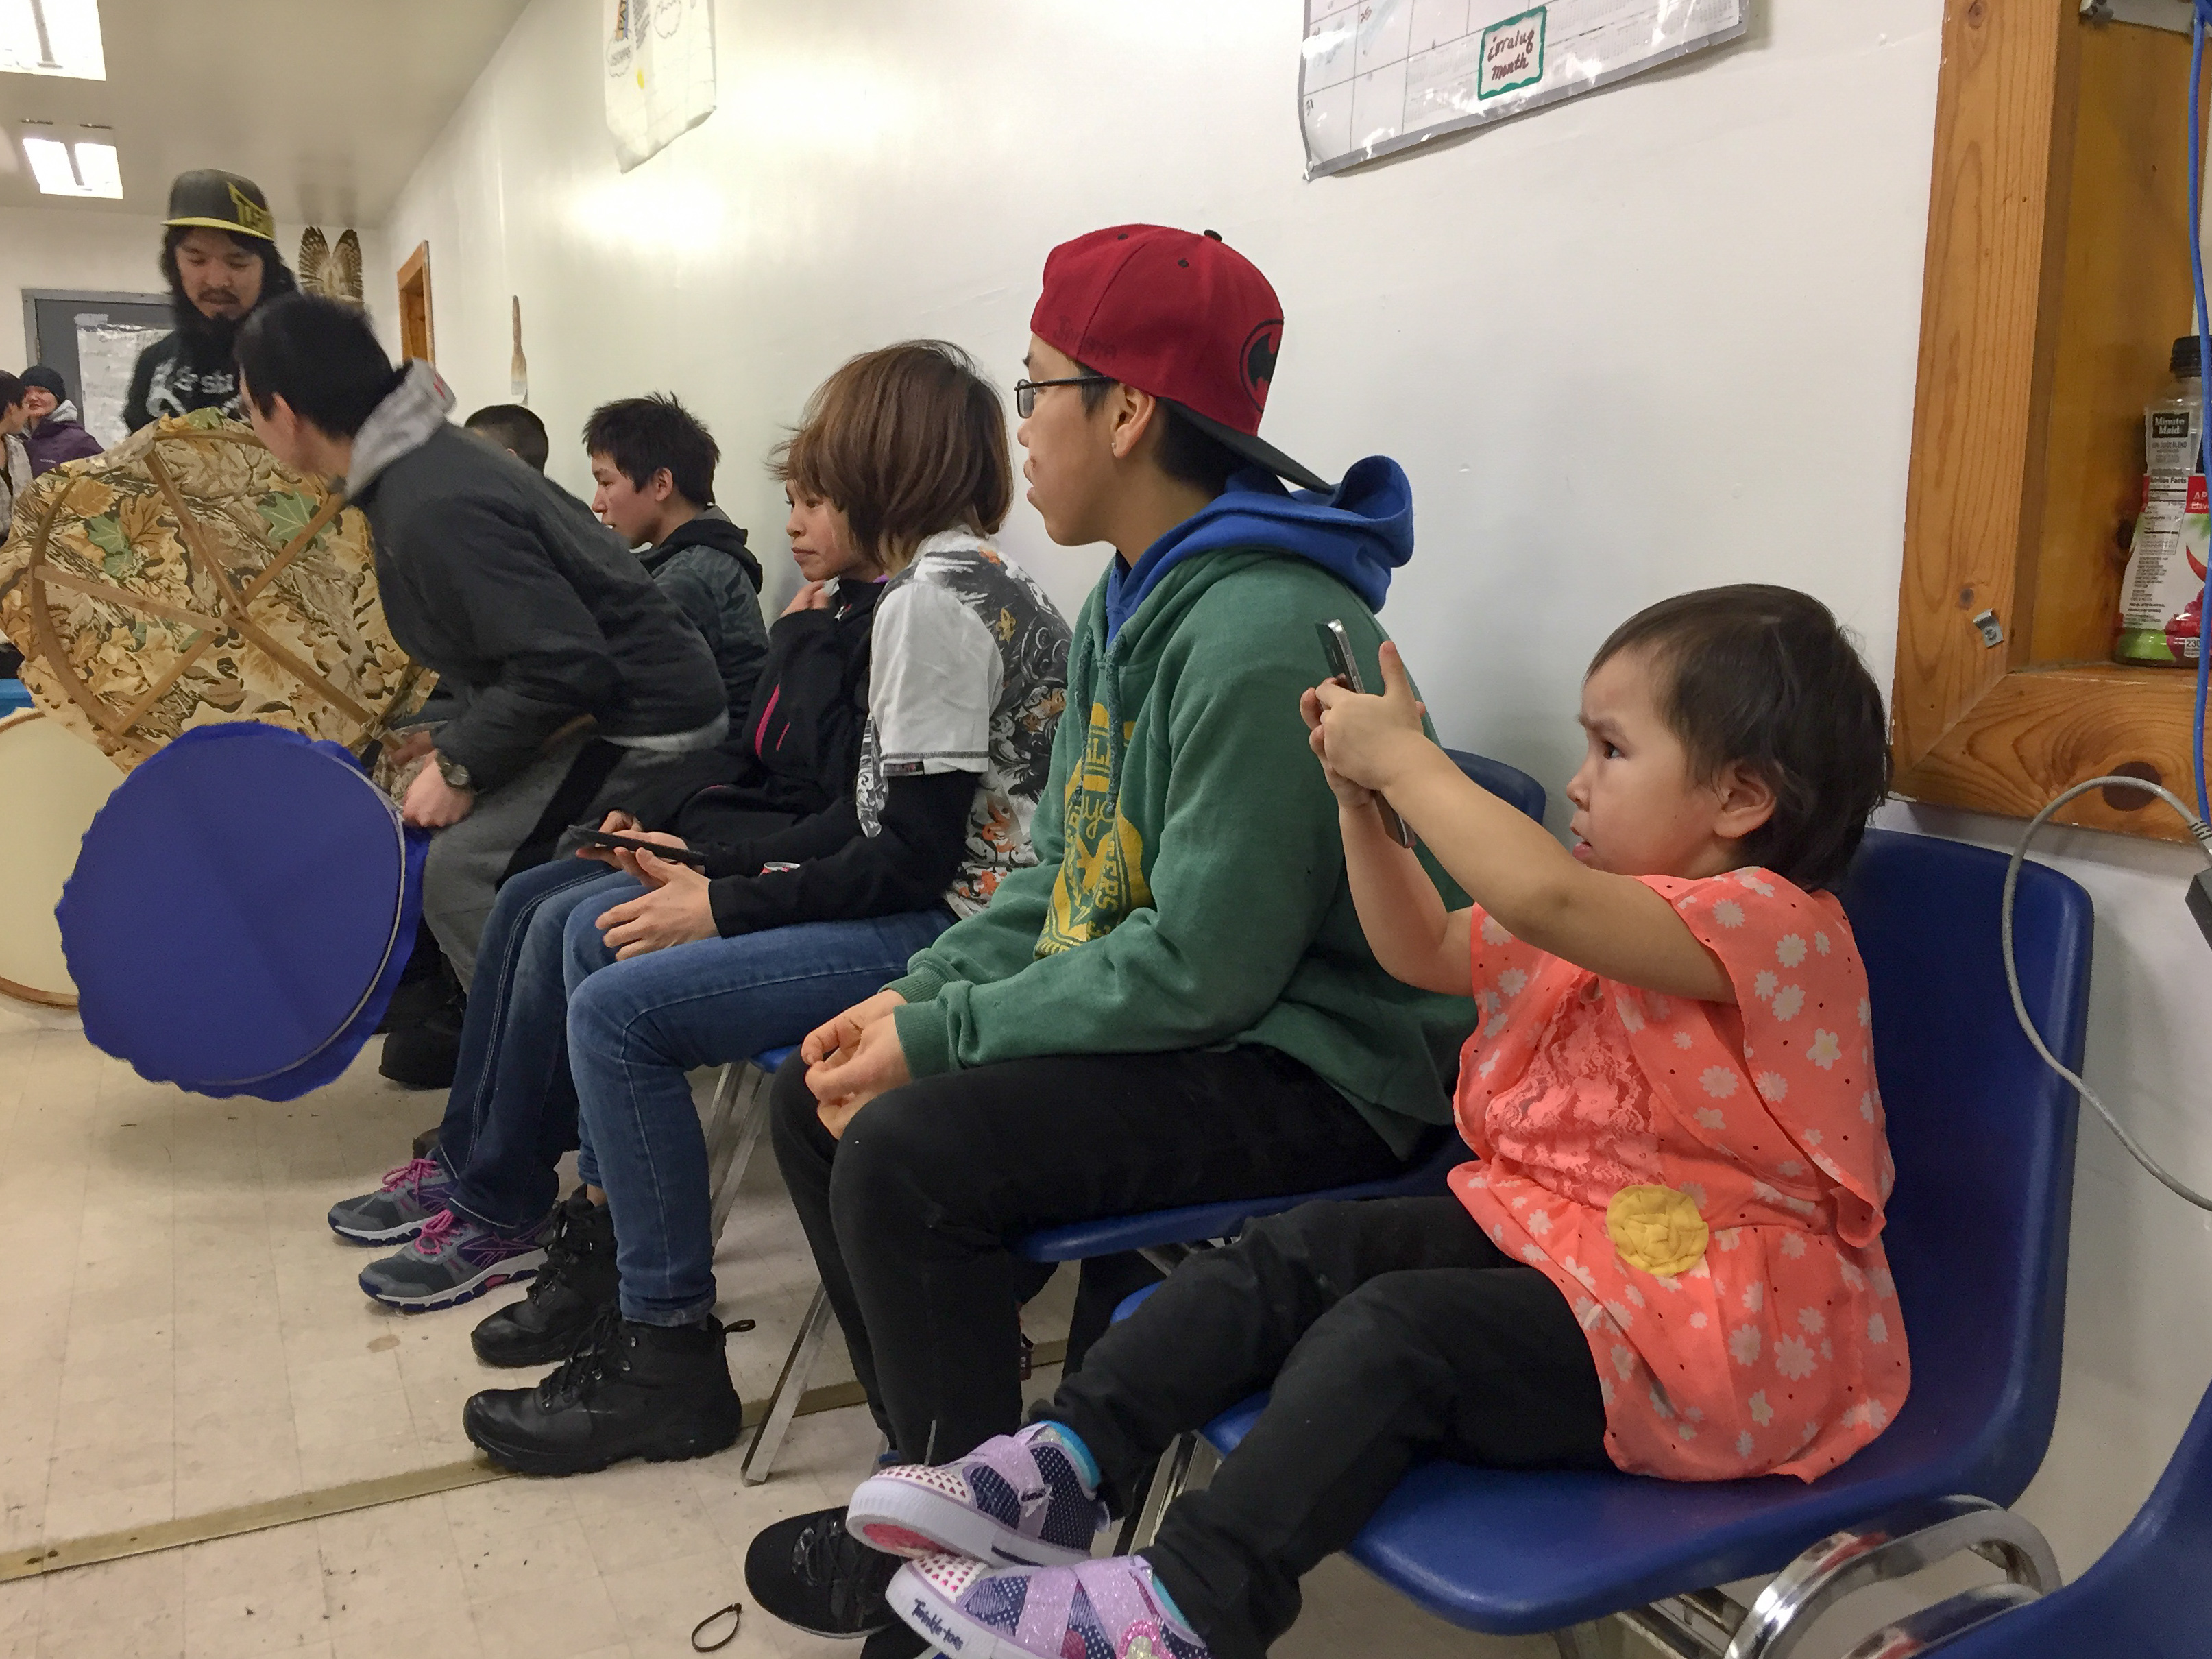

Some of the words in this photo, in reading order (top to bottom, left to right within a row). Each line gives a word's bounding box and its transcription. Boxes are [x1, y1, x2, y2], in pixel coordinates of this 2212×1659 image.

[1492, 52, 1529, 81] month
[2154, 416, 2185, 426] Minute
[2158, 425, 2180, 434] Maid
[2193, 491, 2208, 500] AP
[1095, 840, 1119, 910] TERS
